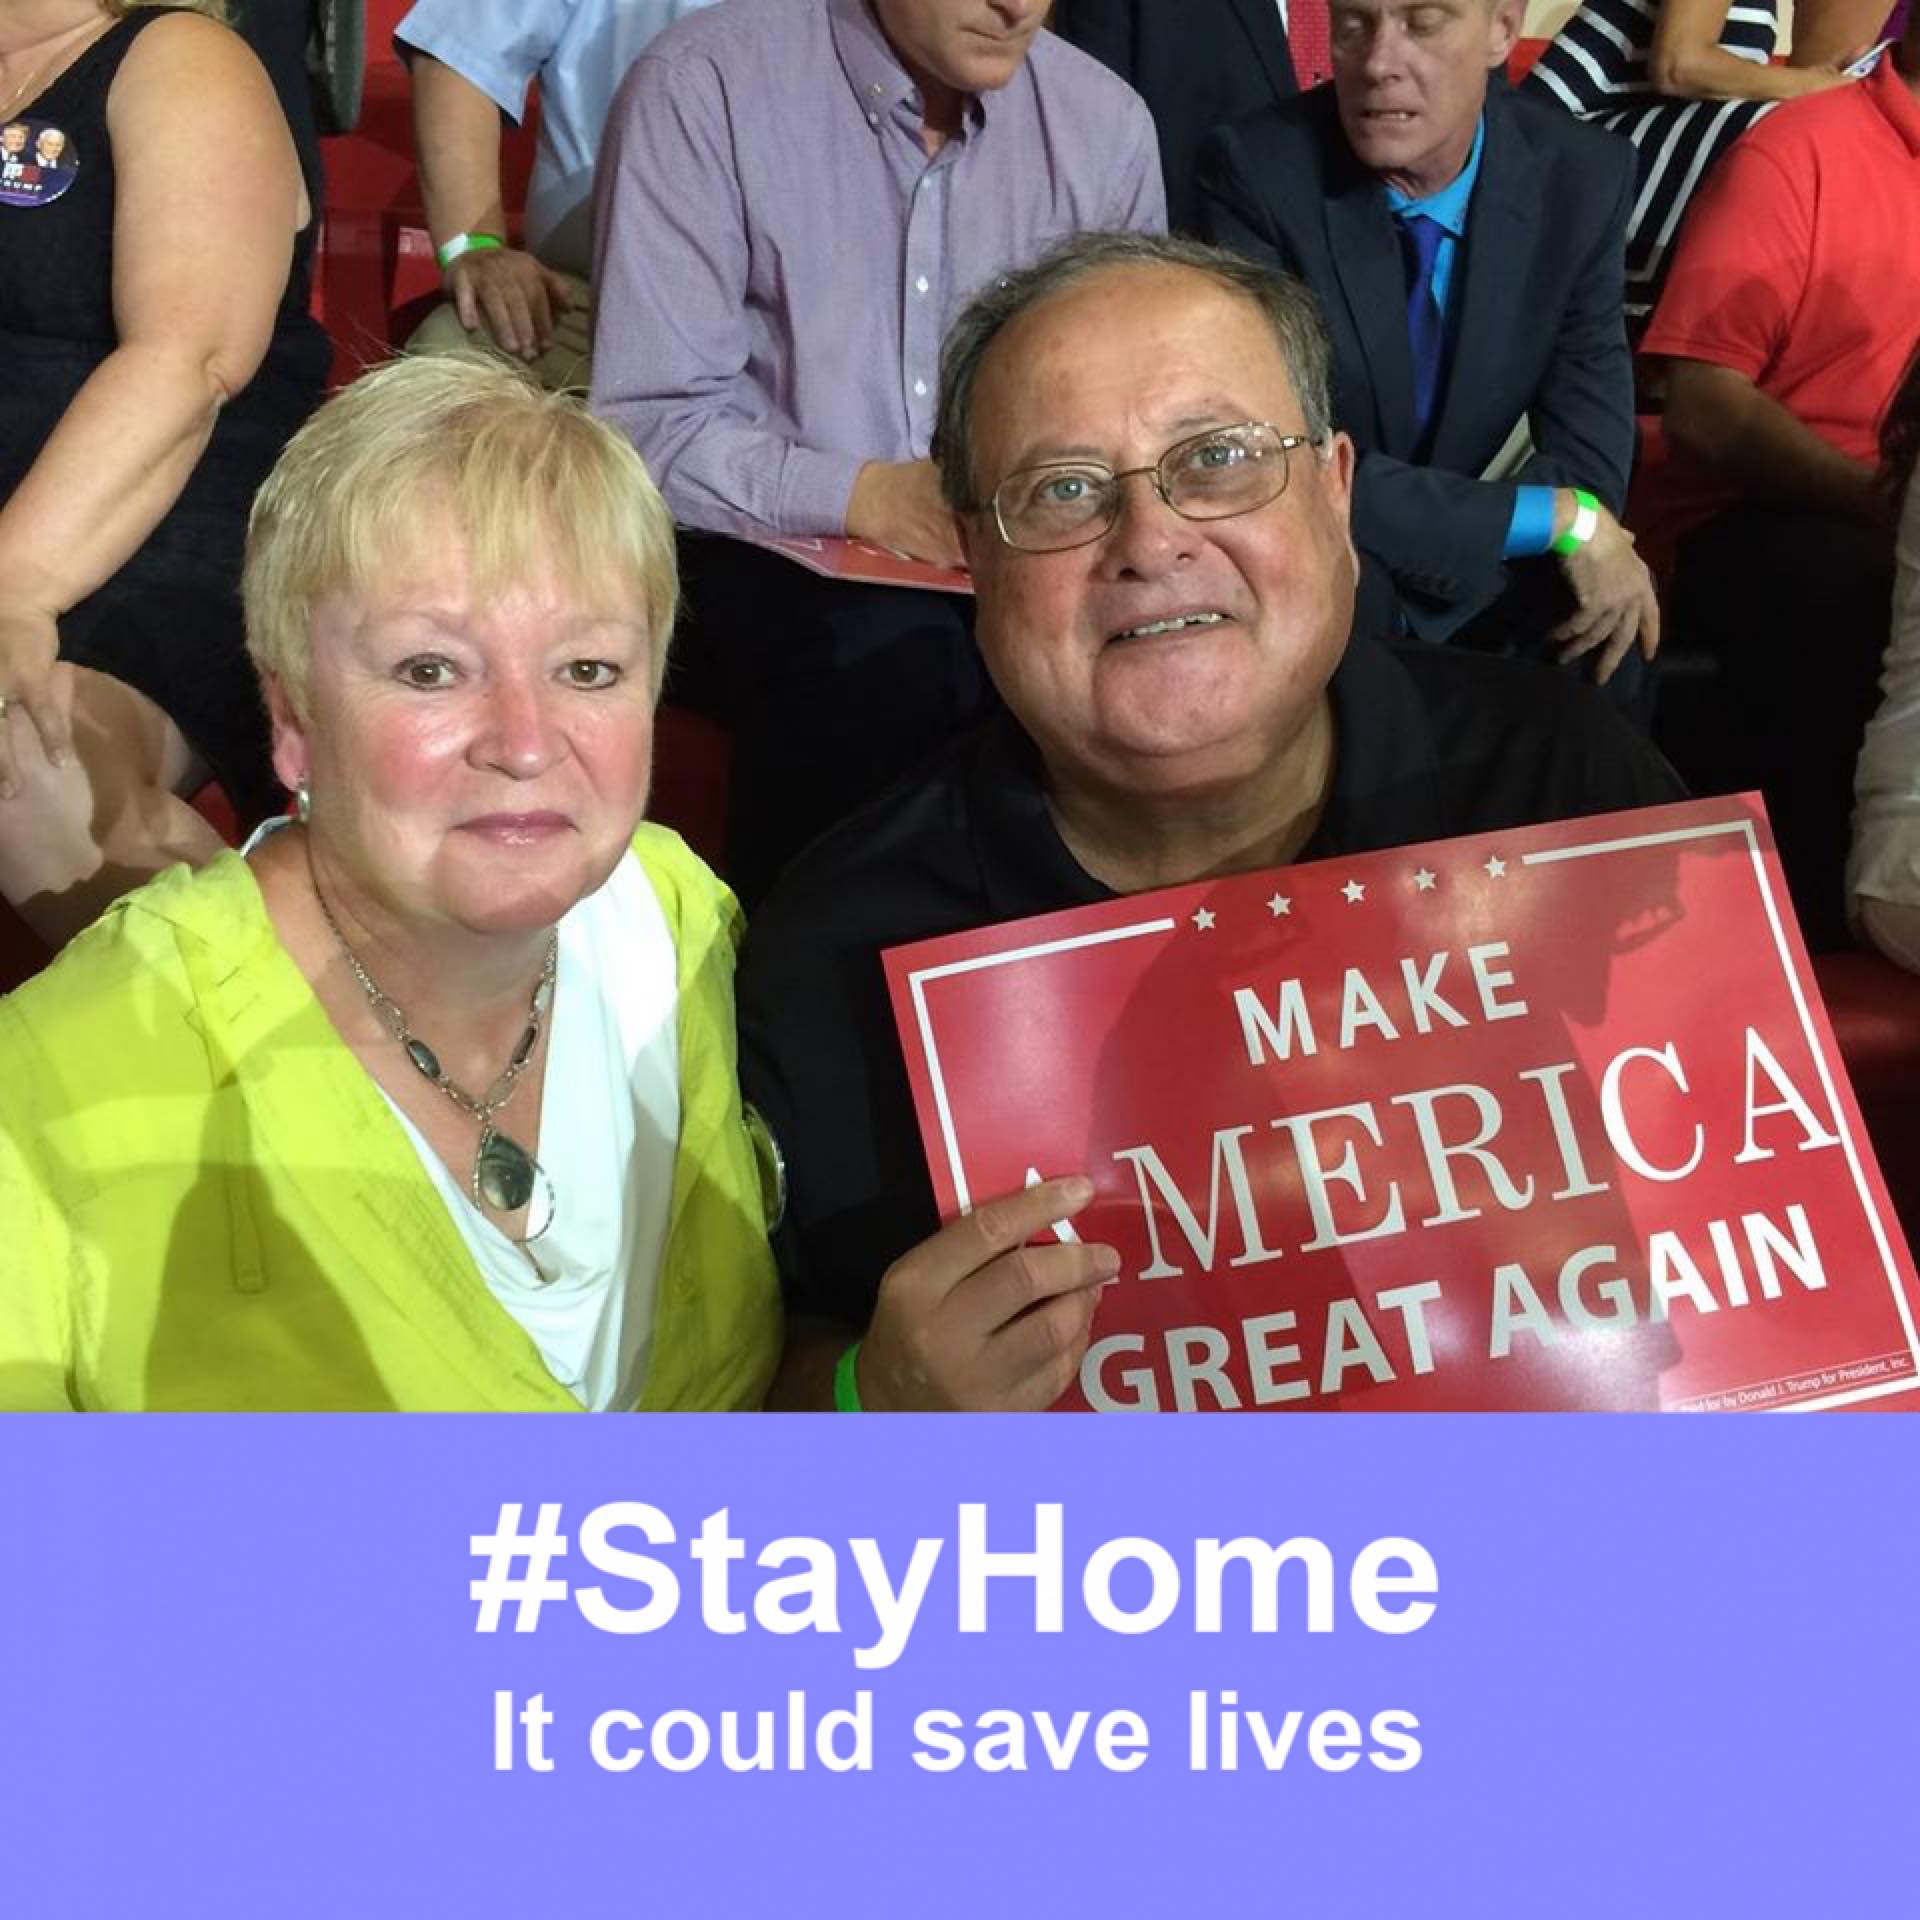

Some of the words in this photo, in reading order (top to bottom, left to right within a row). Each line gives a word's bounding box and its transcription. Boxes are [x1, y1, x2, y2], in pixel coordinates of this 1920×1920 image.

[1233, 941, 1529, 1066] MAKE
[1079, 1280, 1441, 1412] GREAT
[1489, 1203, 1827, 1359] AGAIN
[1738, 1382, 1777, 1403] Donald
[1784, 1376, 1820, 1393] Trump
[1821, 1372, 1837, 1385] for
